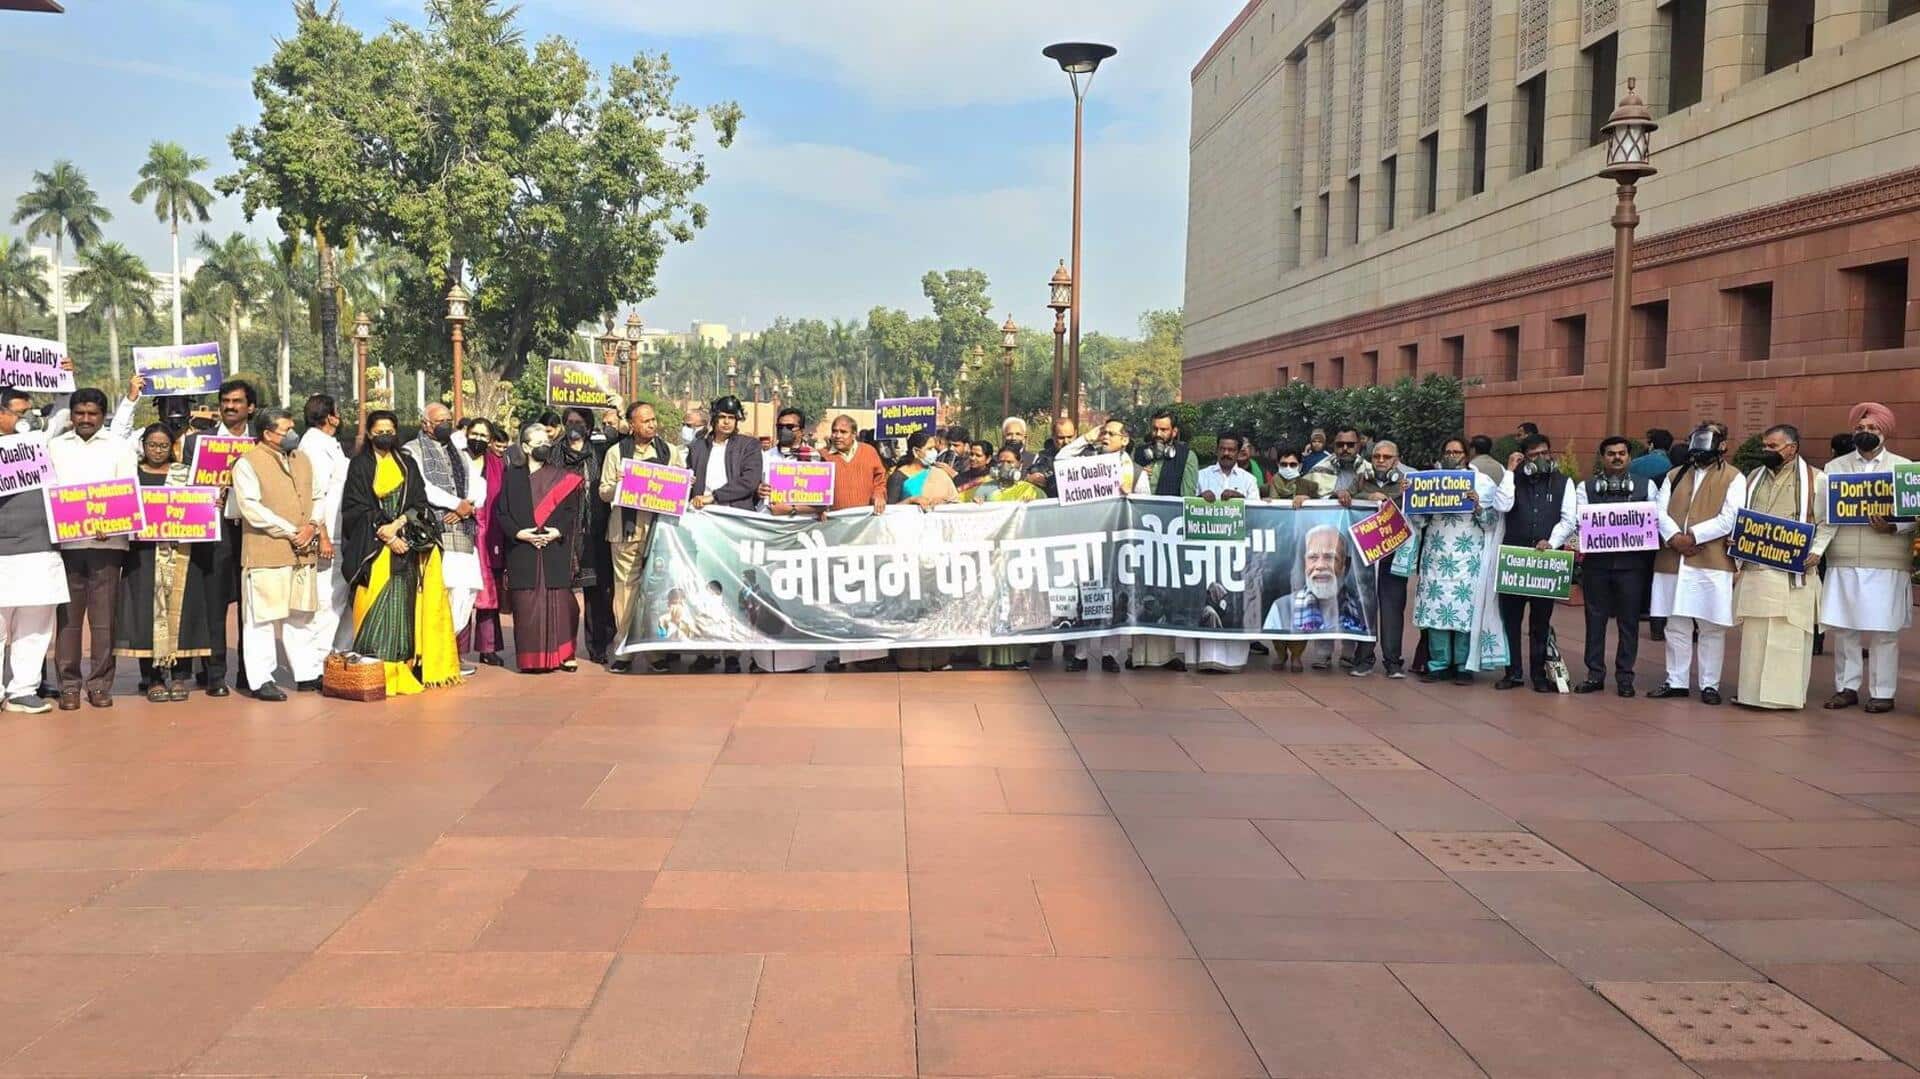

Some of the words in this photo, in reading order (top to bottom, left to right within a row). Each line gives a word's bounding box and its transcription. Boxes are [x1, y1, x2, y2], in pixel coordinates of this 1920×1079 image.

[0, 368, 32, 387] Action
[552, 386, 568, 401] Not
[569, 391, 575, 401] a
[902, 405, 935, 416] Deserves
[885, 424, 894, 435] to
[196, 469, 218, 484] Not
[653, 467, 687, 484] Polluters
[797, 465, 830, 476] Polluters
[648, 479, 664, 494] Pay
[794, 476, 809, 489] Pay
[1441, 475, 1471, 490] Choke
[1874, 480, 1894, 497] Cho
[87, 483, 134, 499] Polluters
[142, 490, 169, 504] Make
[169, 491, 213, 504] Polluters
[621, 490, 639, 505] Not
[770, 490, 787, 503] Not
[1065, 486, 1093, 502] Action
[1411, 493, 1428, 508] Our
[86, 501, 107, 516] Pay
[166, 504, 185, 520] Pay
[1205, 505, 1213, 517] Air
[1213, 505, 1220, 517] is
[1836, 500, 1858, 518] Our
[57, 521, 82, 539] Not
[1187, 519, 1201, 534] Not
[1201, 523, 1206, 534] a
[1379, 524, 1393, 538] Pay
[1586, 532, 1620, 550] Action
[1772, 524, 1807, 548] Choke
[1737, 535, 1757, 554] Our
[1365, 544, 1384, 561] Not
[1525, 556, 1537, 569] Air
[1537, 556, 1544, 569] is
[1543, 559, 1549, 570] a
[1501, 570, 1518, 586] Not
[1518, 575, 1525, 587] a
